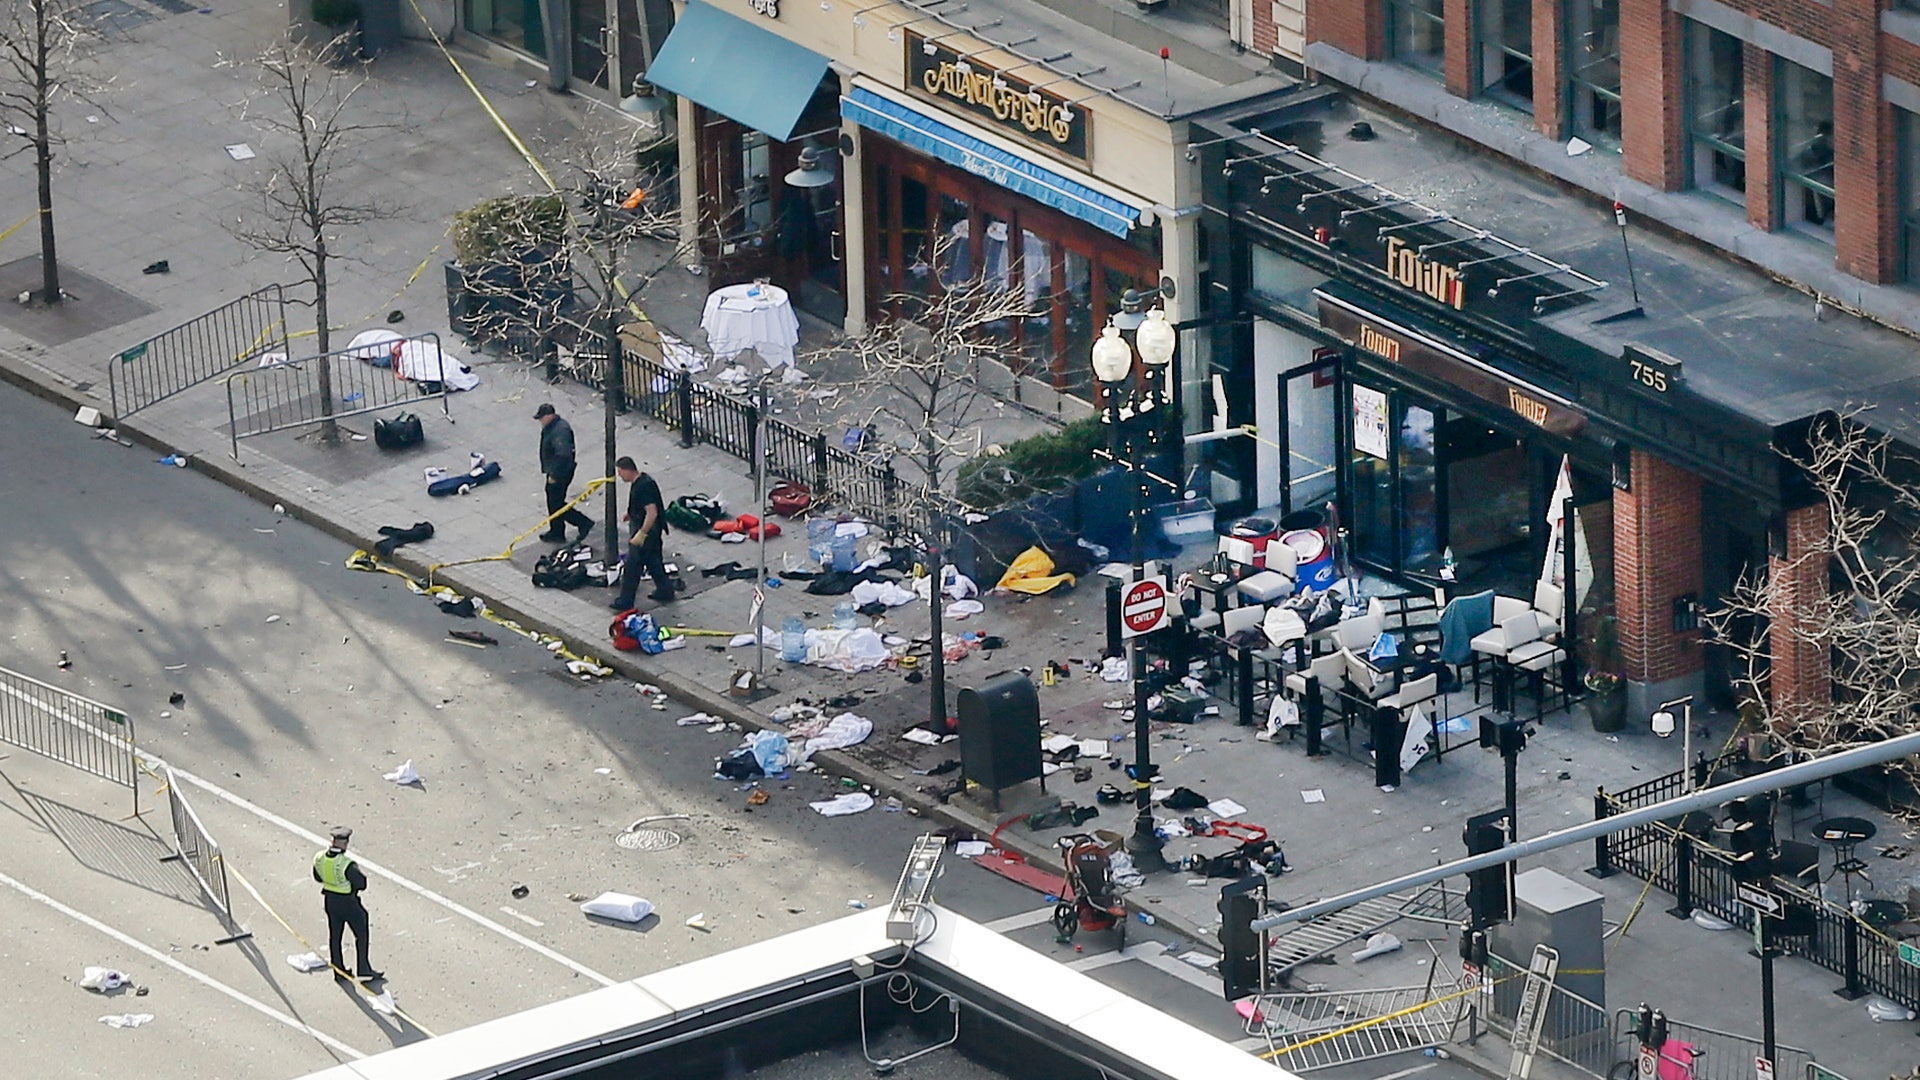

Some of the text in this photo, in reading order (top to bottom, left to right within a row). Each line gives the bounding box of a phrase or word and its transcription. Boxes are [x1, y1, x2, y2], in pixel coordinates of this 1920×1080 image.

[1630, 360, 1667, 391] 755
[1131, 588, 1157, 603] DO NOT
[1134, 611, 1155, 624] ENTER
